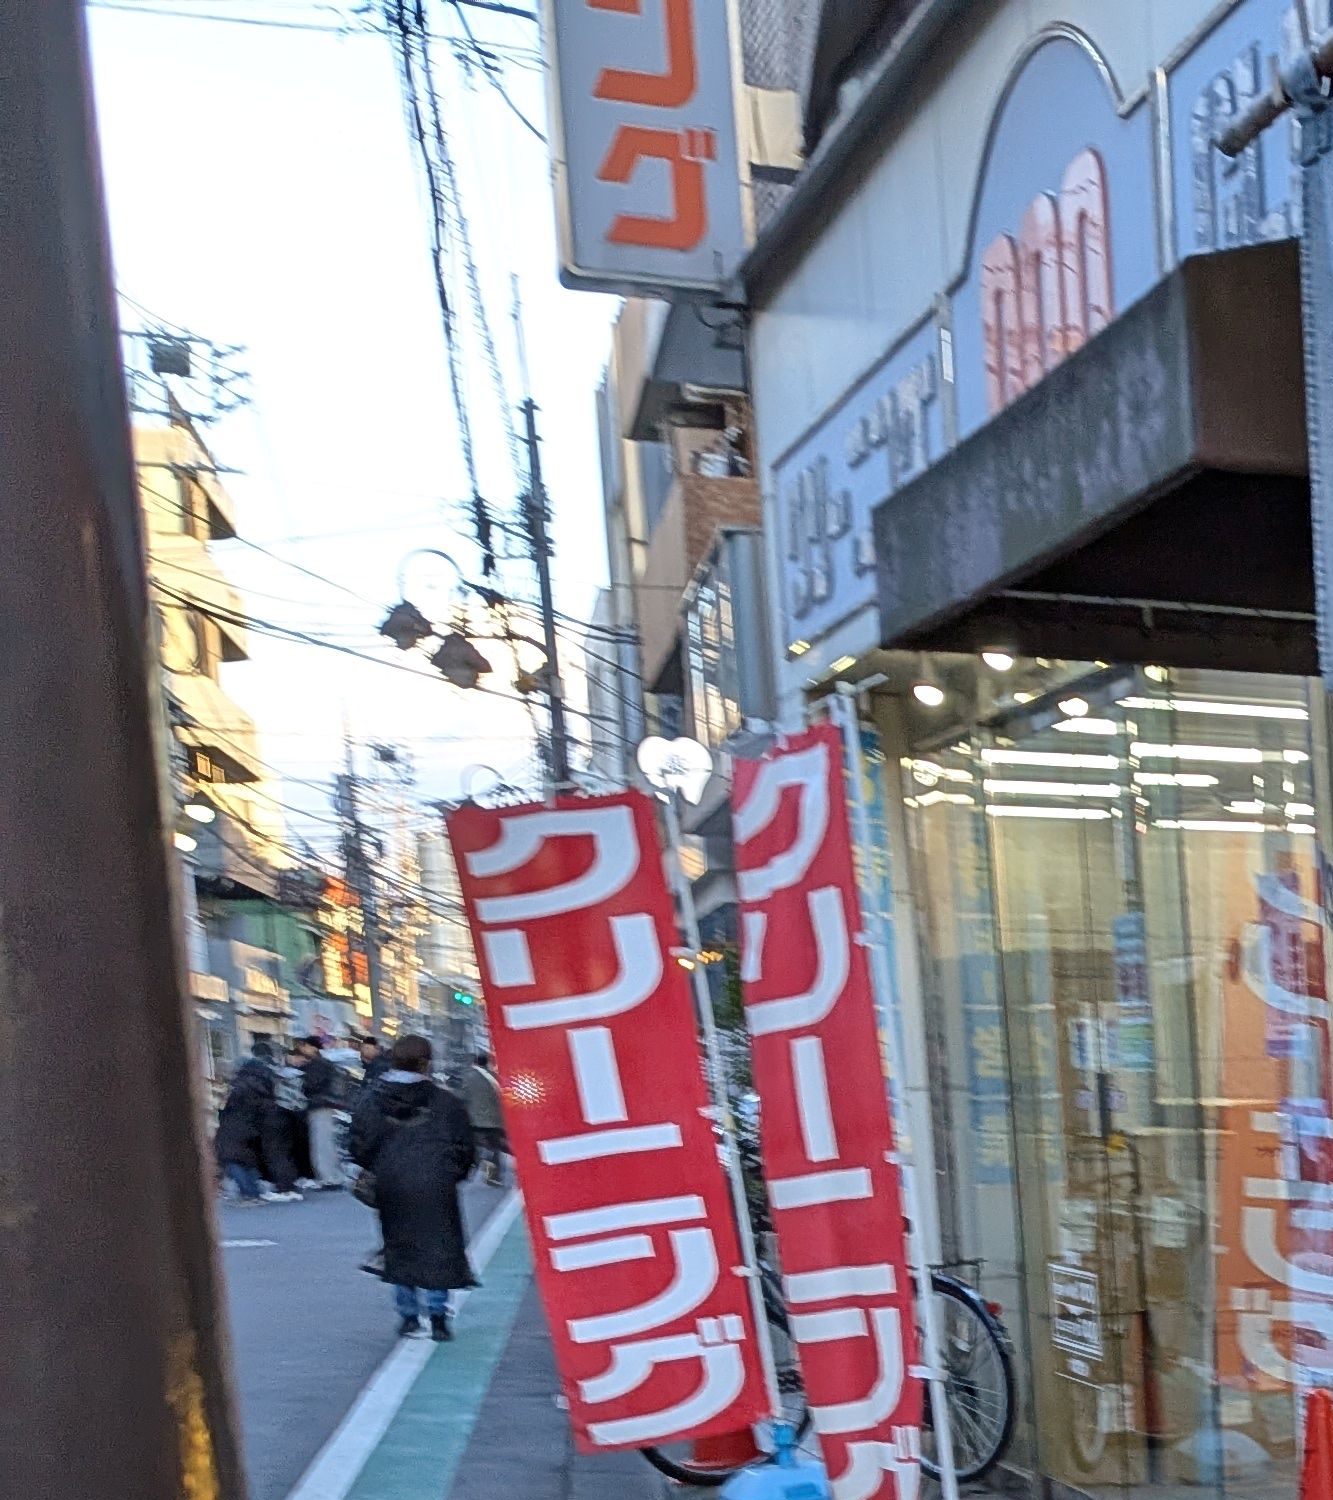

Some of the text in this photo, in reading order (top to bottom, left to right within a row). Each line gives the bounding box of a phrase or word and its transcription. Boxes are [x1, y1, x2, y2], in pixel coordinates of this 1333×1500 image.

[466, 804, 747, 1447] クリーニング
